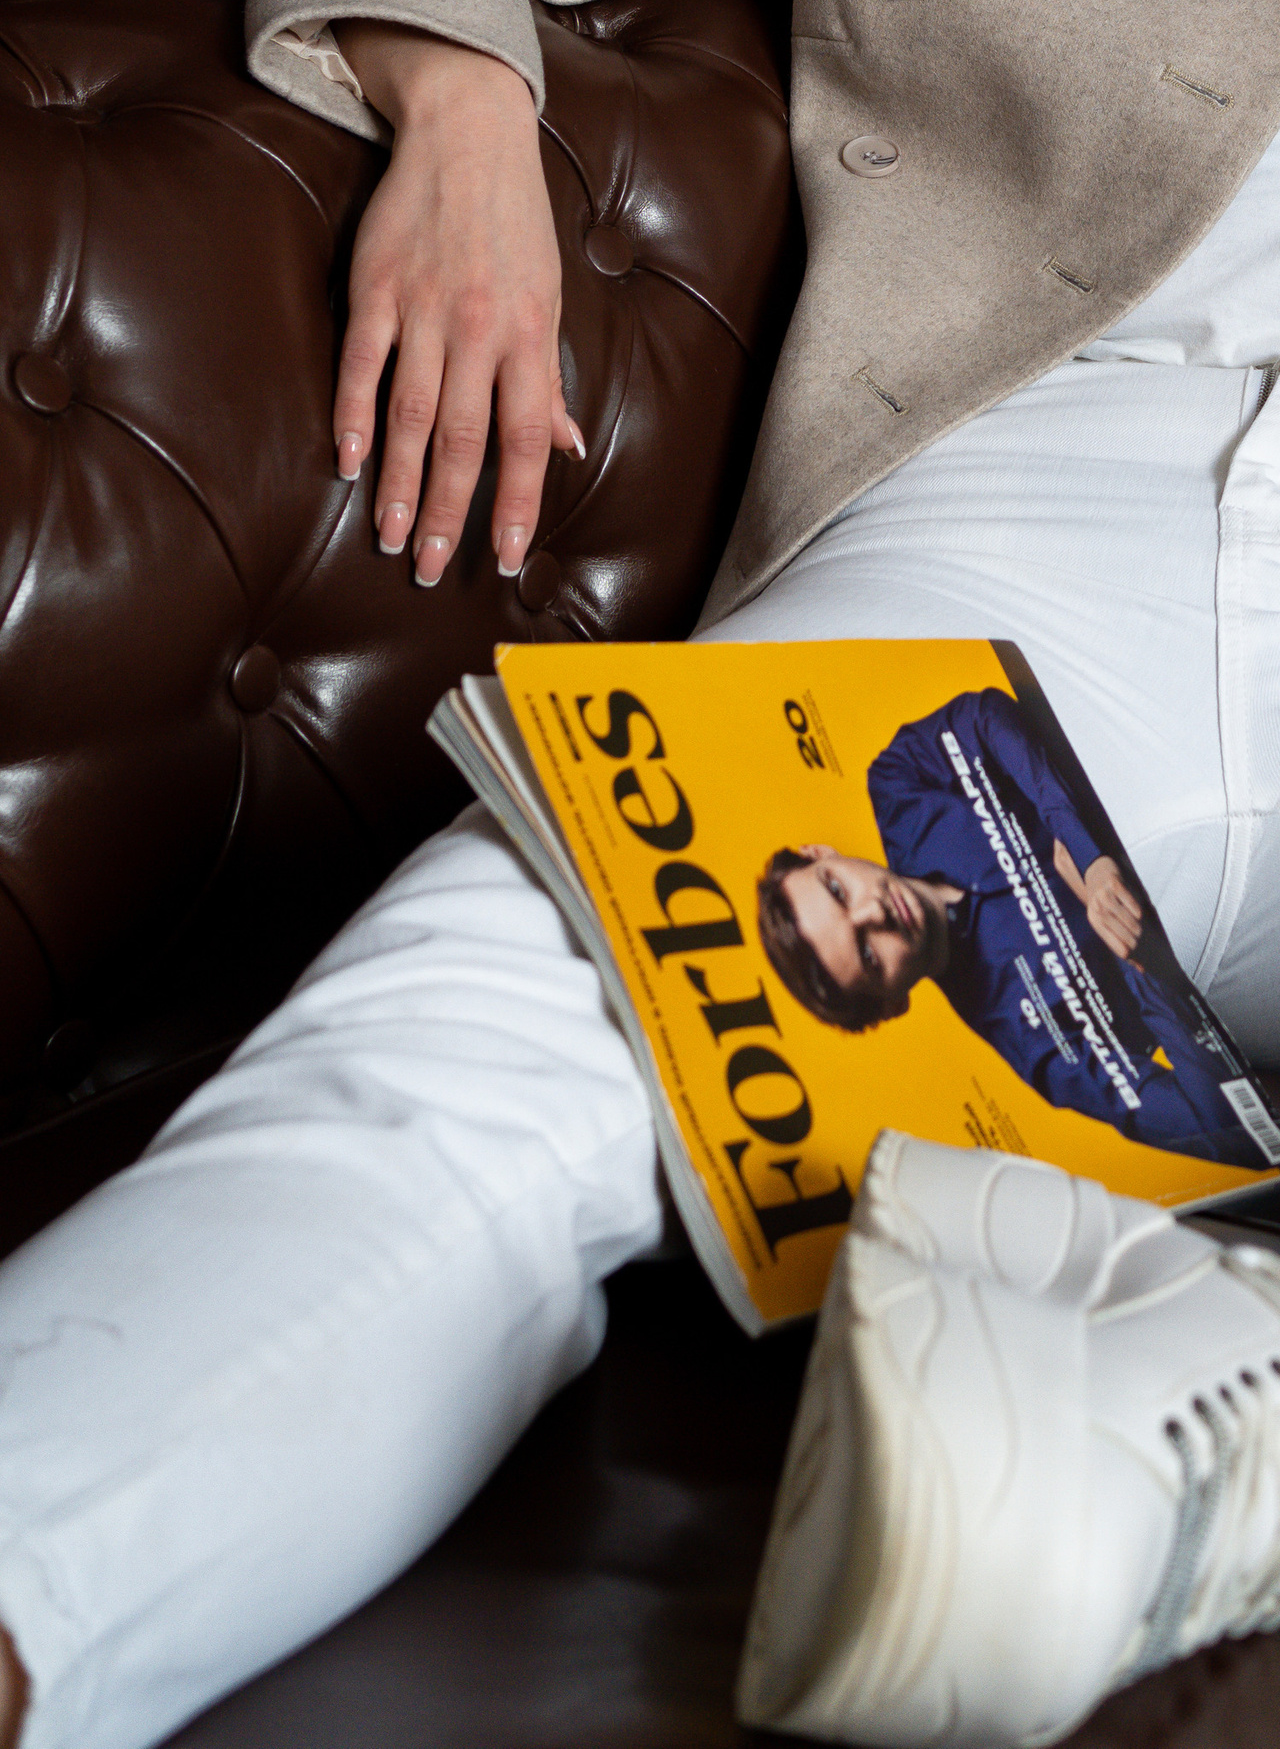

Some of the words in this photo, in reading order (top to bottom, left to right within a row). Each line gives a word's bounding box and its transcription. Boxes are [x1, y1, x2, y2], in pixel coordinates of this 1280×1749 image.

[779, 697, 827, 772] 20
[938, 731, 1051, 945] ПОНОМАРЕВ
[1025, 871, 1051, 912] ГОДА
[1027, 854, 1061, 916] МЕНЯТЬ
[574, 686, 853, 1264] Forbes
[1045, 913, 1080, 974] ЧЕТЫРЕ
[1057, 918, 1098, 990] ДОСТОИН
[1016, 997, 1041, 1029] 10
[1038, 951, 1142, 1109] ВИТАЛИЙ
[1095, 992, 1115, 1021] ЧТО
